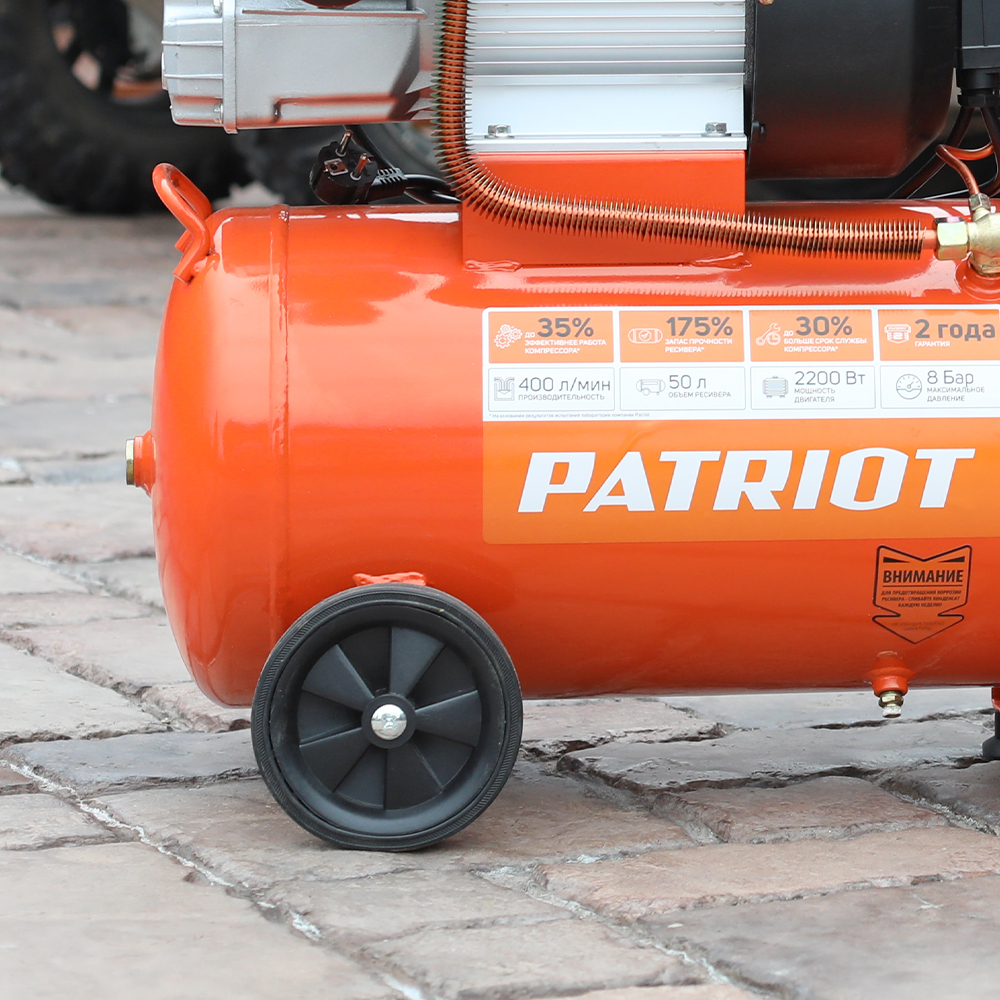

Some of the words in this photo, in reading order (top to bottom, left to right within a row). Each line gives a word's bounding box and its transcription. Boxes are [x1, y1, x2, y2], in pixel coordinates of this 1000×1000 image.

[537, 318, 594, 338] 35%
[666, 316, 733, 336] 175%
[796, 316, 852, 336] 30%
[914, 319, 930, 338] 2
[938, 324, 996, 342] года
[518, 377, 554, 392] 400
[558, 376, 610, 392] л/мин
[669, 374, 692, 389] 50
[696, 378, 706, 389] л
[794, 370, 840, 385] 2200
[846, 370, 866, 384] Вт
[927, 370, 938, 384] 8
[944, 370, 974, 387] Бар
[518, 447, 976, 512] PATRIOT
[883, 570, 964, 583] ВНИМАНИЕ
